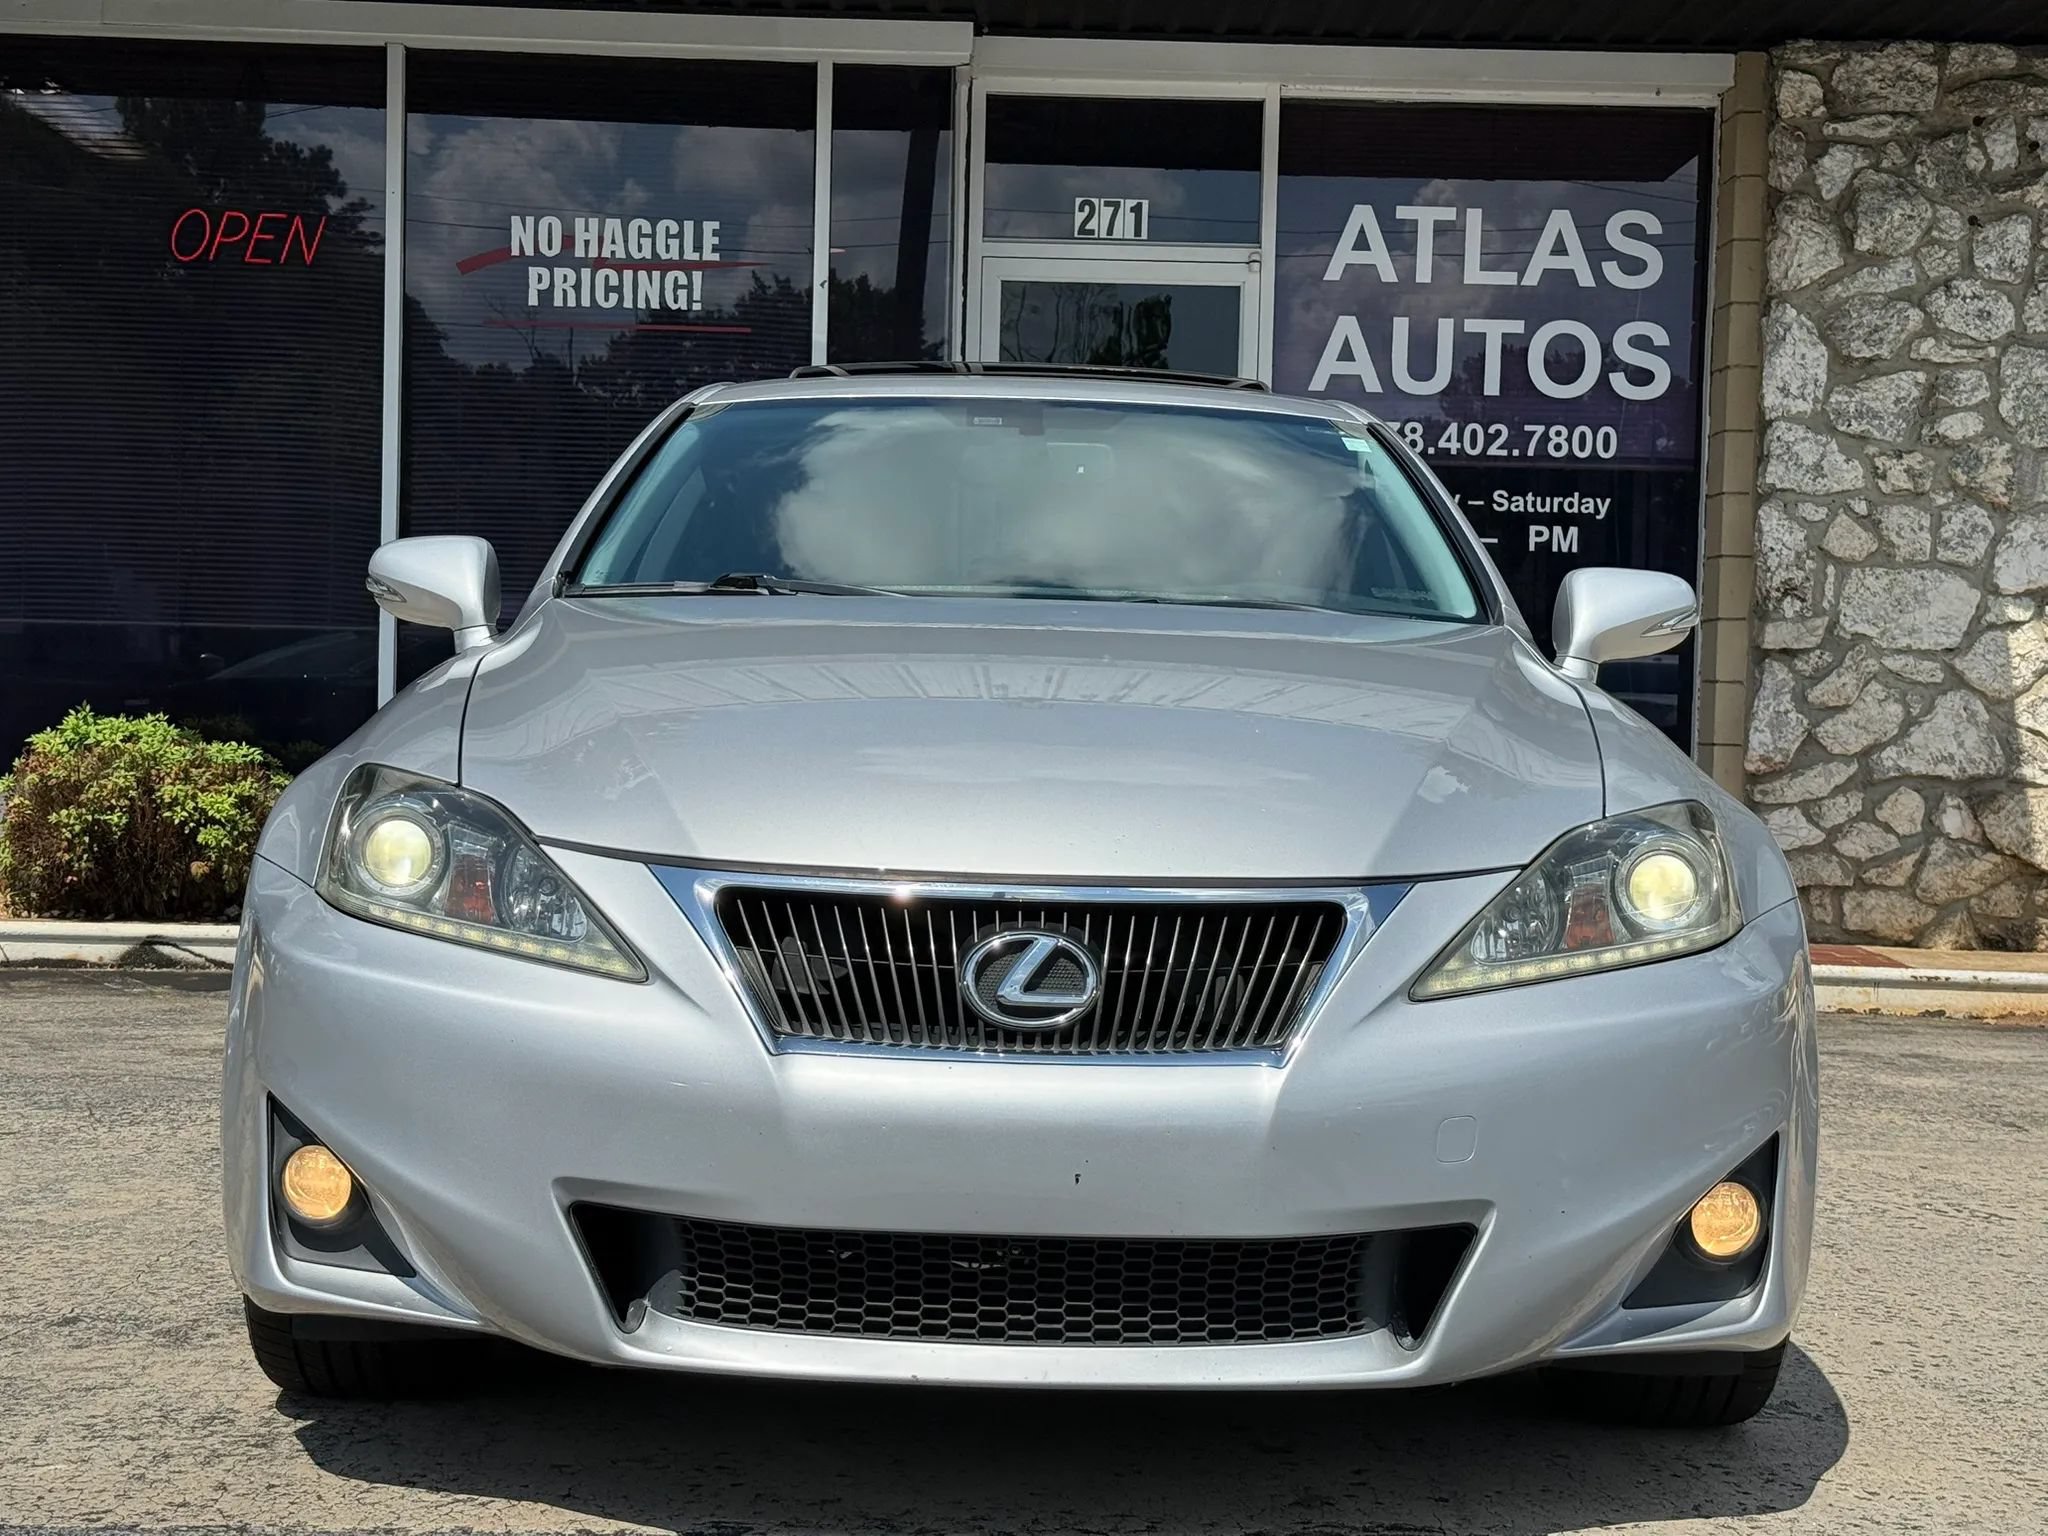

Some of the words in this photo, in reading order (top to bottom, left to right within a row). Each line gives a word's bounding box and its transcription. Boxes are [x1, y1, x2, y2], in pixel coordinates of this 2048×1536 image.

[171, 208, 326, 265] OPEN
[510, 215, 562, 257] NO
[574, 217, 720, 262] HAGGLE
[1076, 198, 1145, 238] 271
[1322, 203, 1664, 290] ATLAS
[528, 266, 703, 311] PRICING!
[1307, 314, 1671, 401] AUTOS
[1492, 489, 1611, 520] Saturday
[1528, 525, 1579, 553] PM
